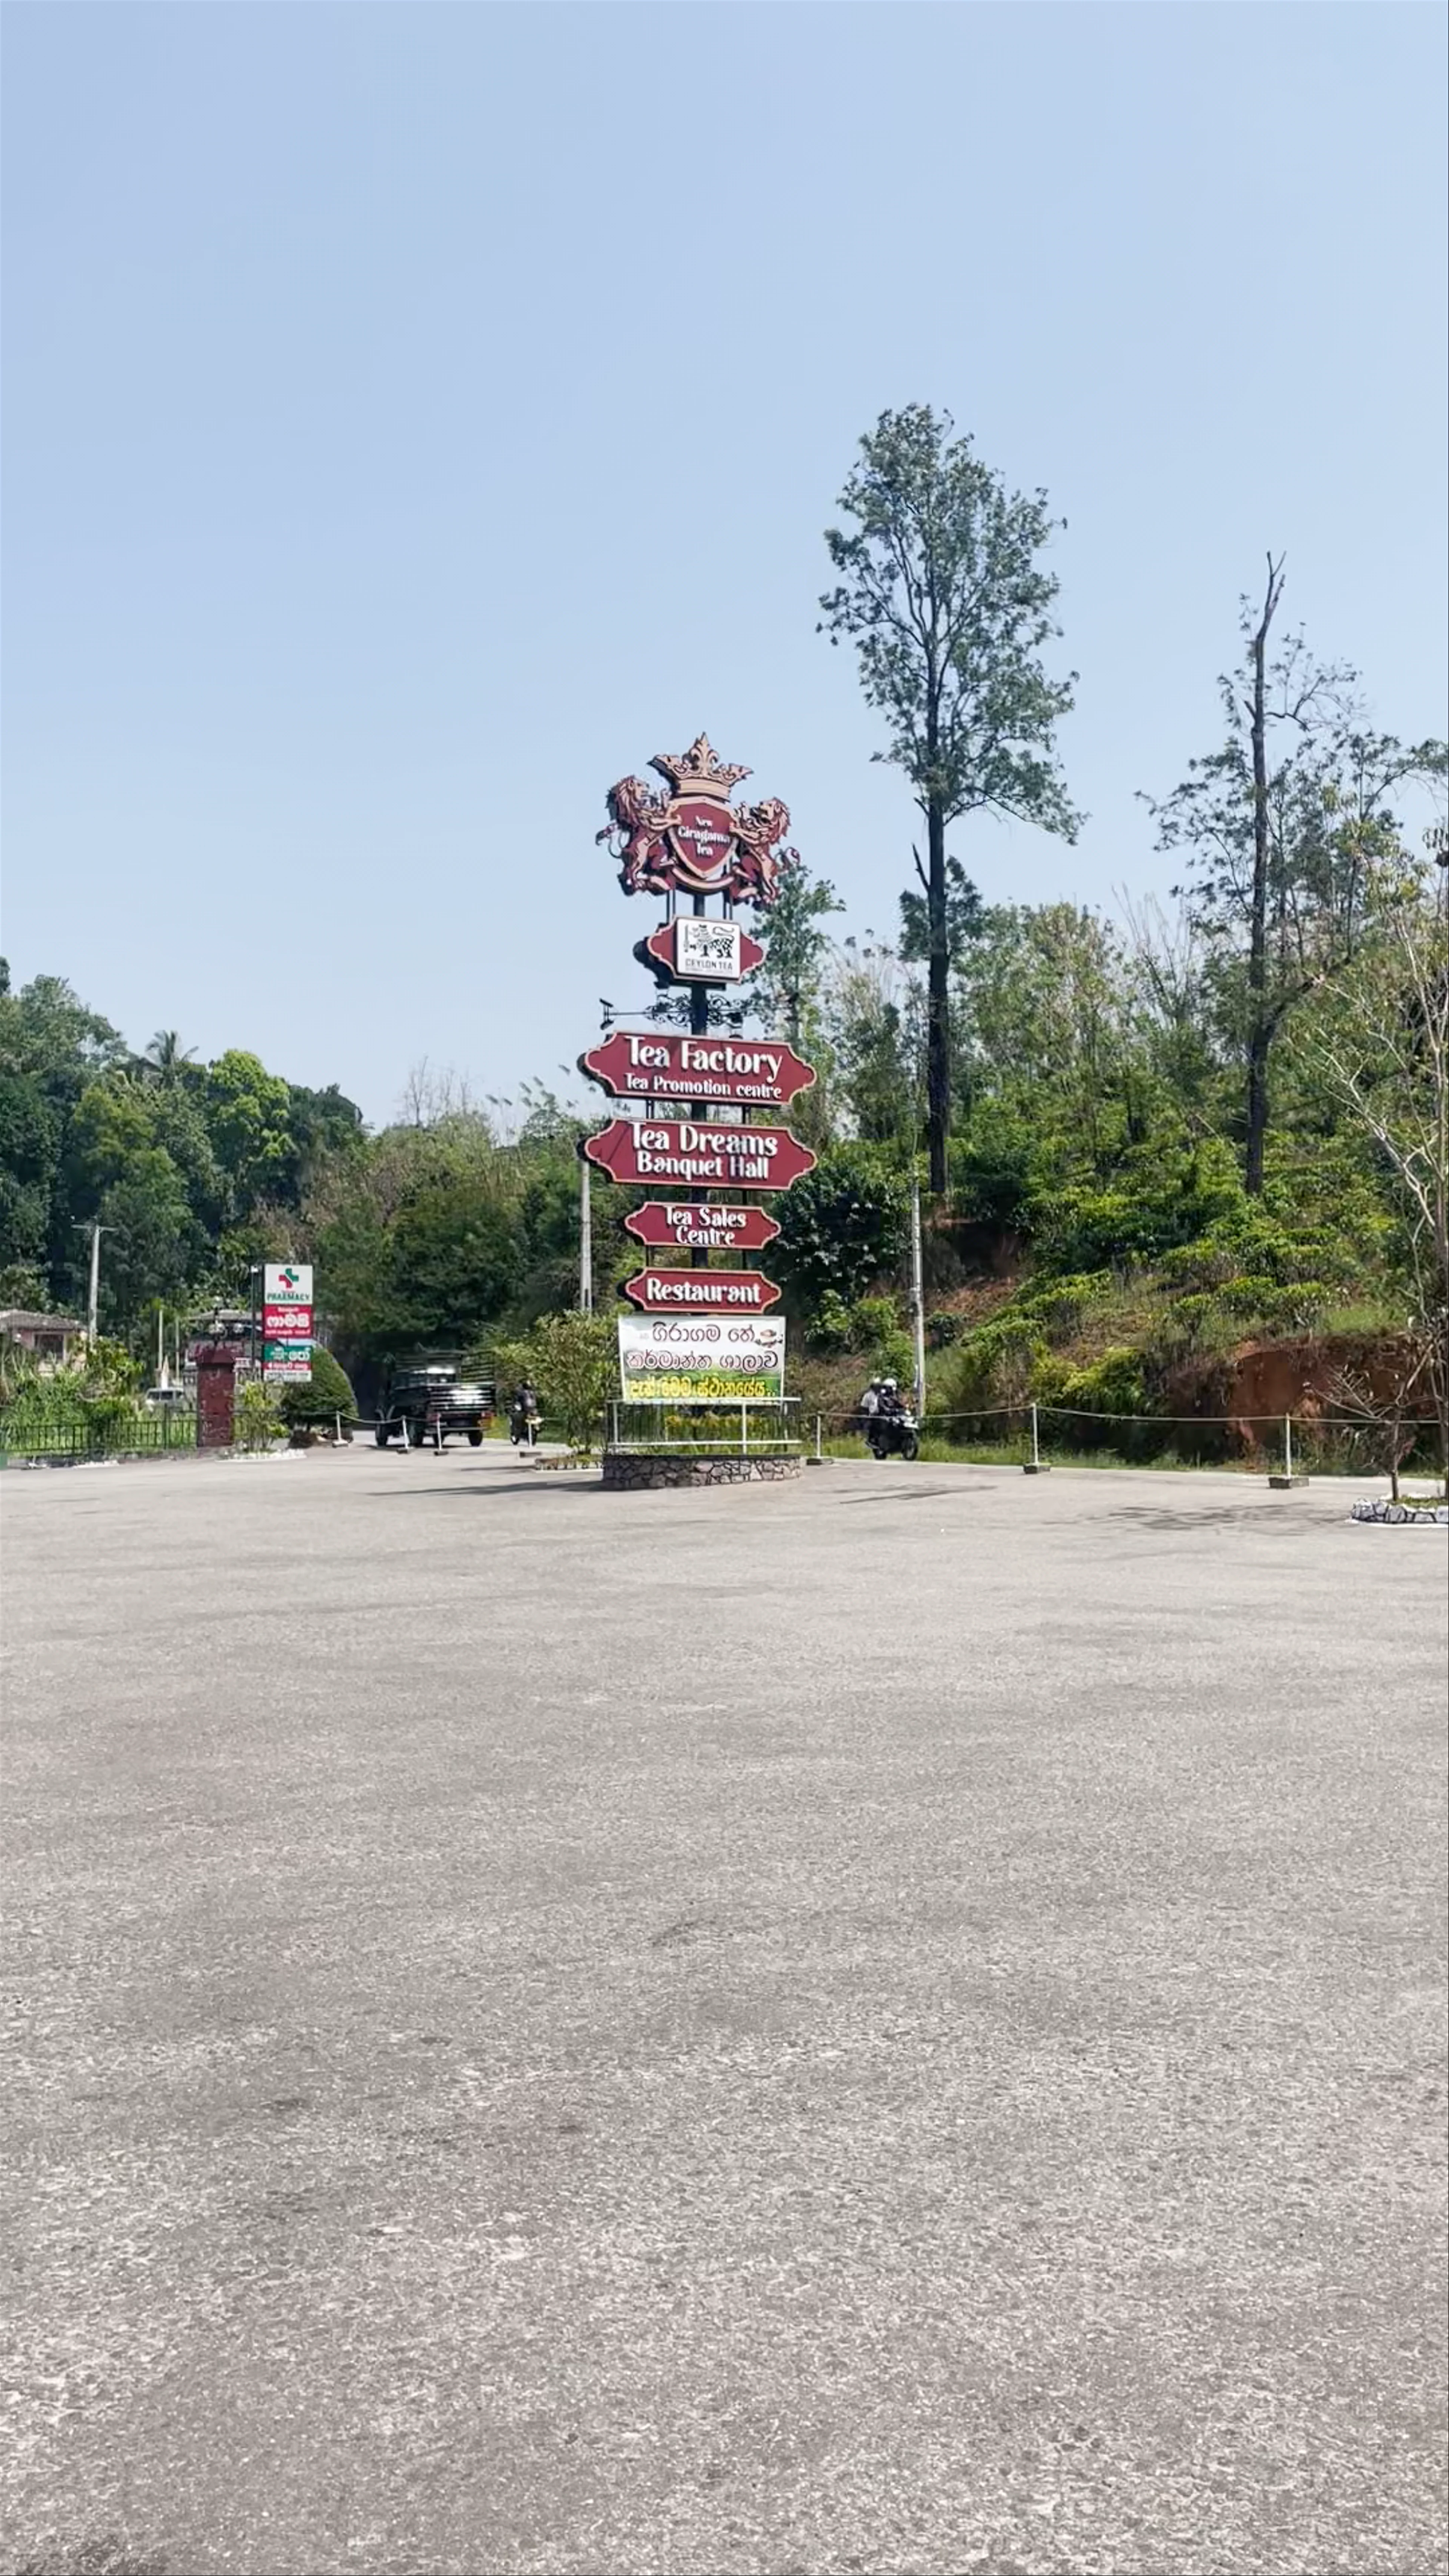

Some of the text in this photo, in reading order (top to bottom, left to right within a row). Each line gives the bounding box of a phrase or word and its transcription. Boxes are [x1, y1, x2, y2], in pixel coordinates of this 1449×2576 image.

[695, 842, 713, 856] Tea
[685, 958, 733, 970] CEYLON TEA
[625, 1035, 783, 1083] Tea Factory
[625, 1073, 782, 1099] Tea Promotion centre
[627, 1121, 778, 1157] Tea Dreams
[637, 1151, 768, 1181] Banquet Hall
[664, 1205, 746, 1228] Tea Sales
[675, 1226, 735, 1245] Centre
[646, 1278, 761, 1303] Restaurant
[653, 1321, 755, 1342] ගිරාගම තේ
[720, 1350, 778, 1372] ශාලාව
